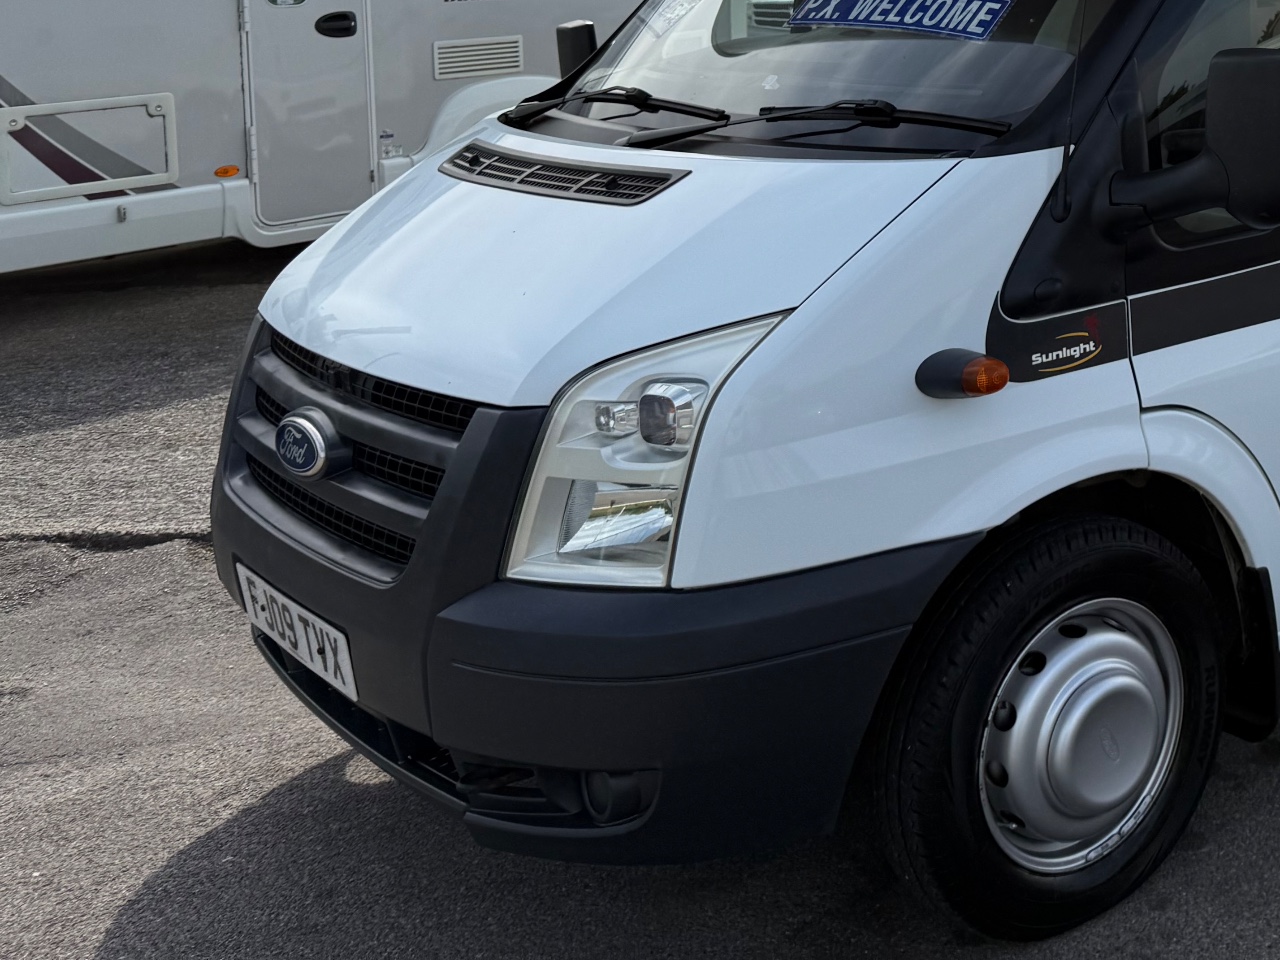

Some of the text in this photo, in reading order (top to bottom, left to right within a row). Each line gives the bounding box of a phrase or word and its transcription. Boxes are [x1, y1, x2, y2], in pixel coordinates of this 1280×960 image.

[1031, 340, 1096, 366] Sunlight
[280, 426, 308, 465] Ford
[245, 576, 299, 652] FJ09
